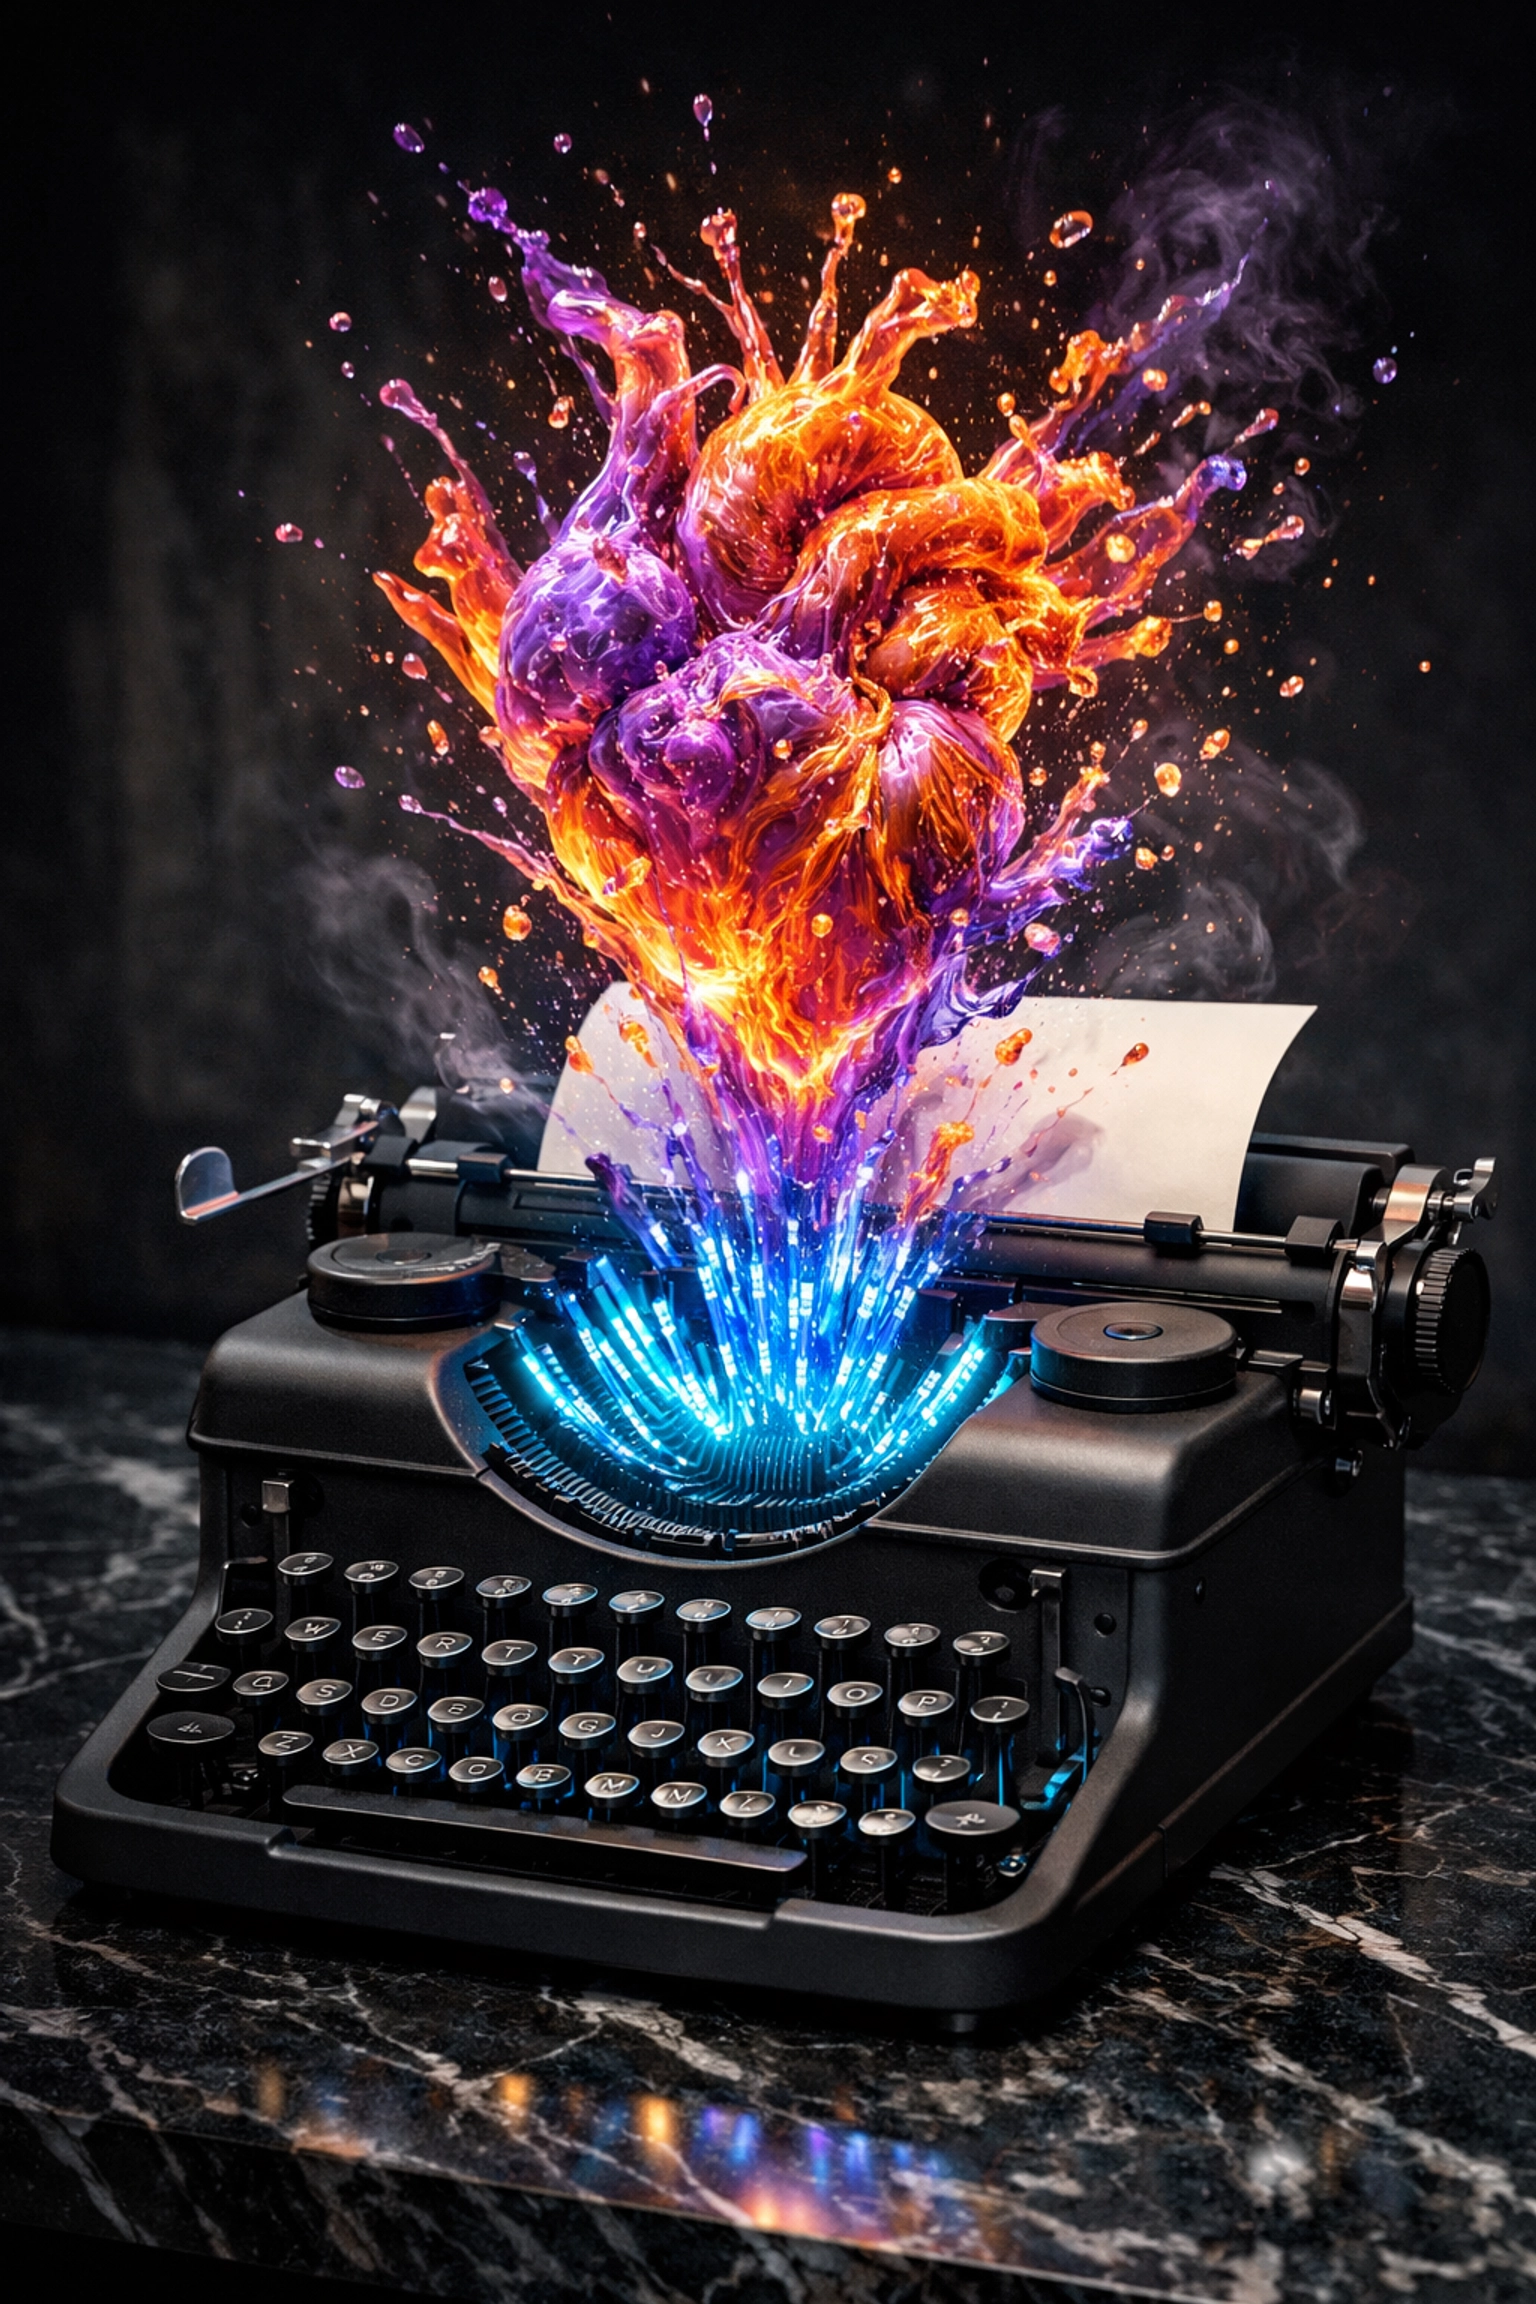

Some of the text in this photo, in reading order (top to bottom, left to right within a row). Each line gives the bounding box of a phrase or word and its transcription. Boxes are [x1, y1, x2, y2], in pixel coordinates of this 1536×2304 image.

[371, 1630, 391, 1642] E
[435, 1637, 456, 1650] R
[504, 1645, 521, 1659] T
[571, 1653, 586, 1666] Y
[636, 1664, 657, 1674] U
[316, 1684, 337, 1698] S
[849, 1688, 867, 1701] O
[379, 1695, 399, 1707] D
[916, 1696, 937, 1709] P
[651, 1727, 666, 1738] J
[275, 1735, 300, 1750] Z
[339, 1744, 365, 1759] X
[788, 1746, 801, 1758] L
[405, 1754, 424, 1767] C
